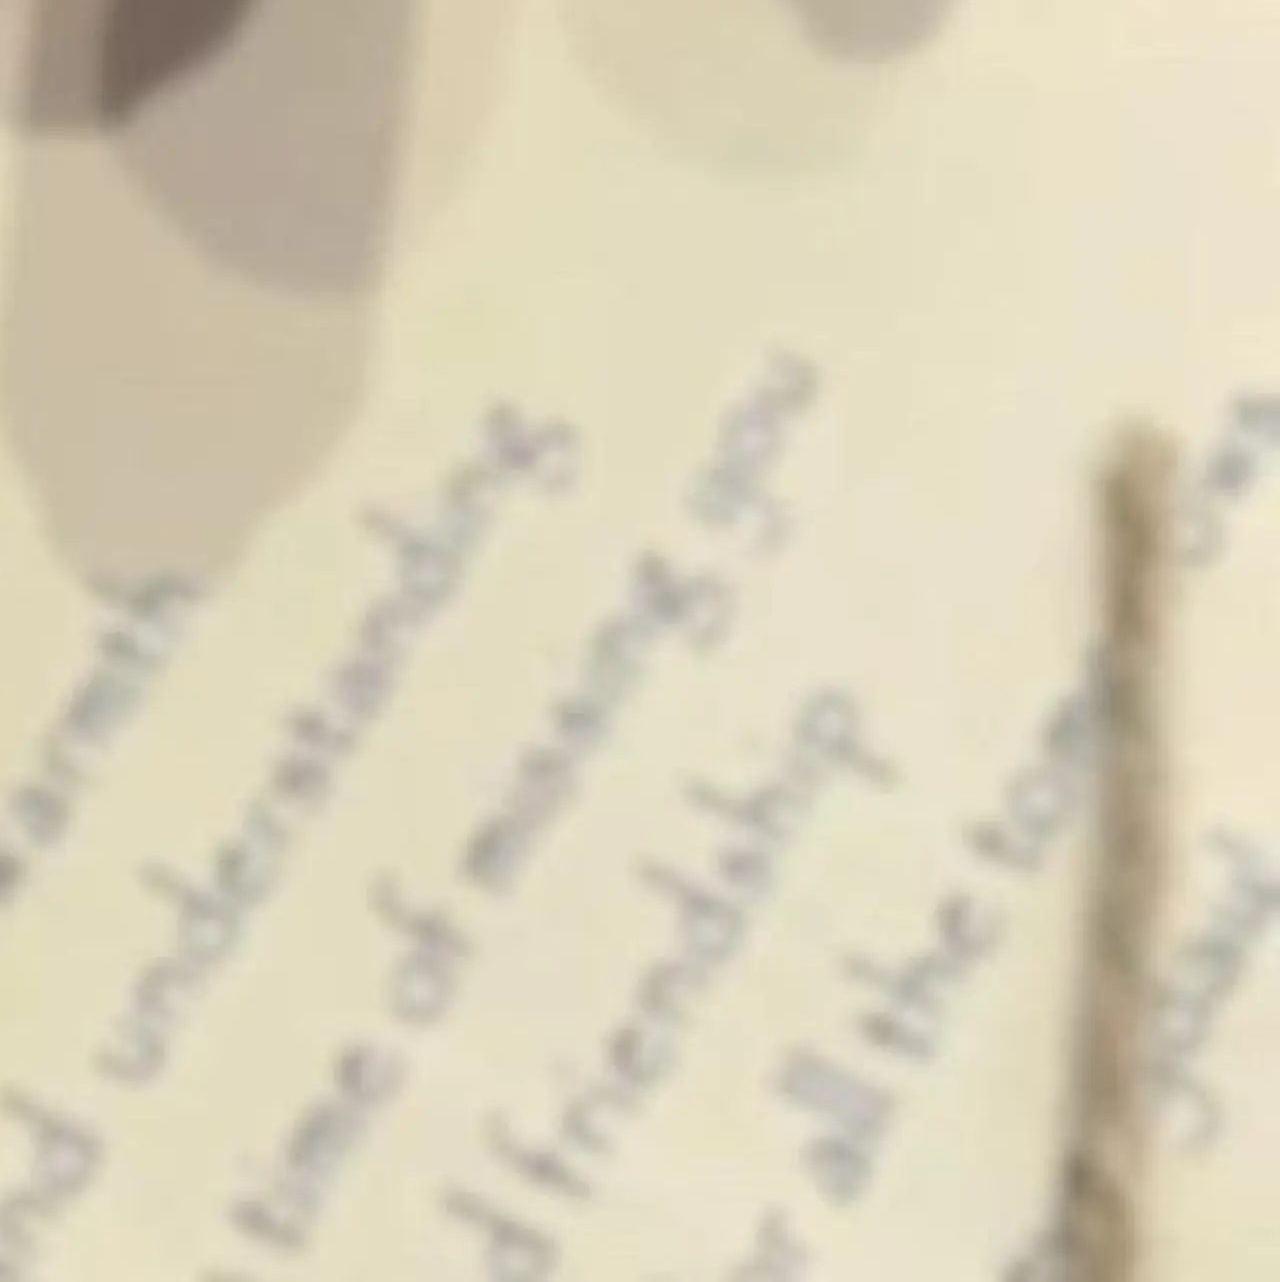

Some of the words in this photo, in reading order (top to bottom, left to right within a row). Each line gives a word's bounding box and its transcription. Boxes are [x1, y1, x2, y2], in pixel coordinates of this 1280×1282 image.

[93, 403, 578, 1085] understanding
[230, 1041, 408, 1257] time
[367, 868, 473, 1025] of
[692, 349, 819, 558] you
[482, 688, 901, 1198] friendship
[773, 1045, 898, 1206] all
[842, 890, 1000, 1057] the
